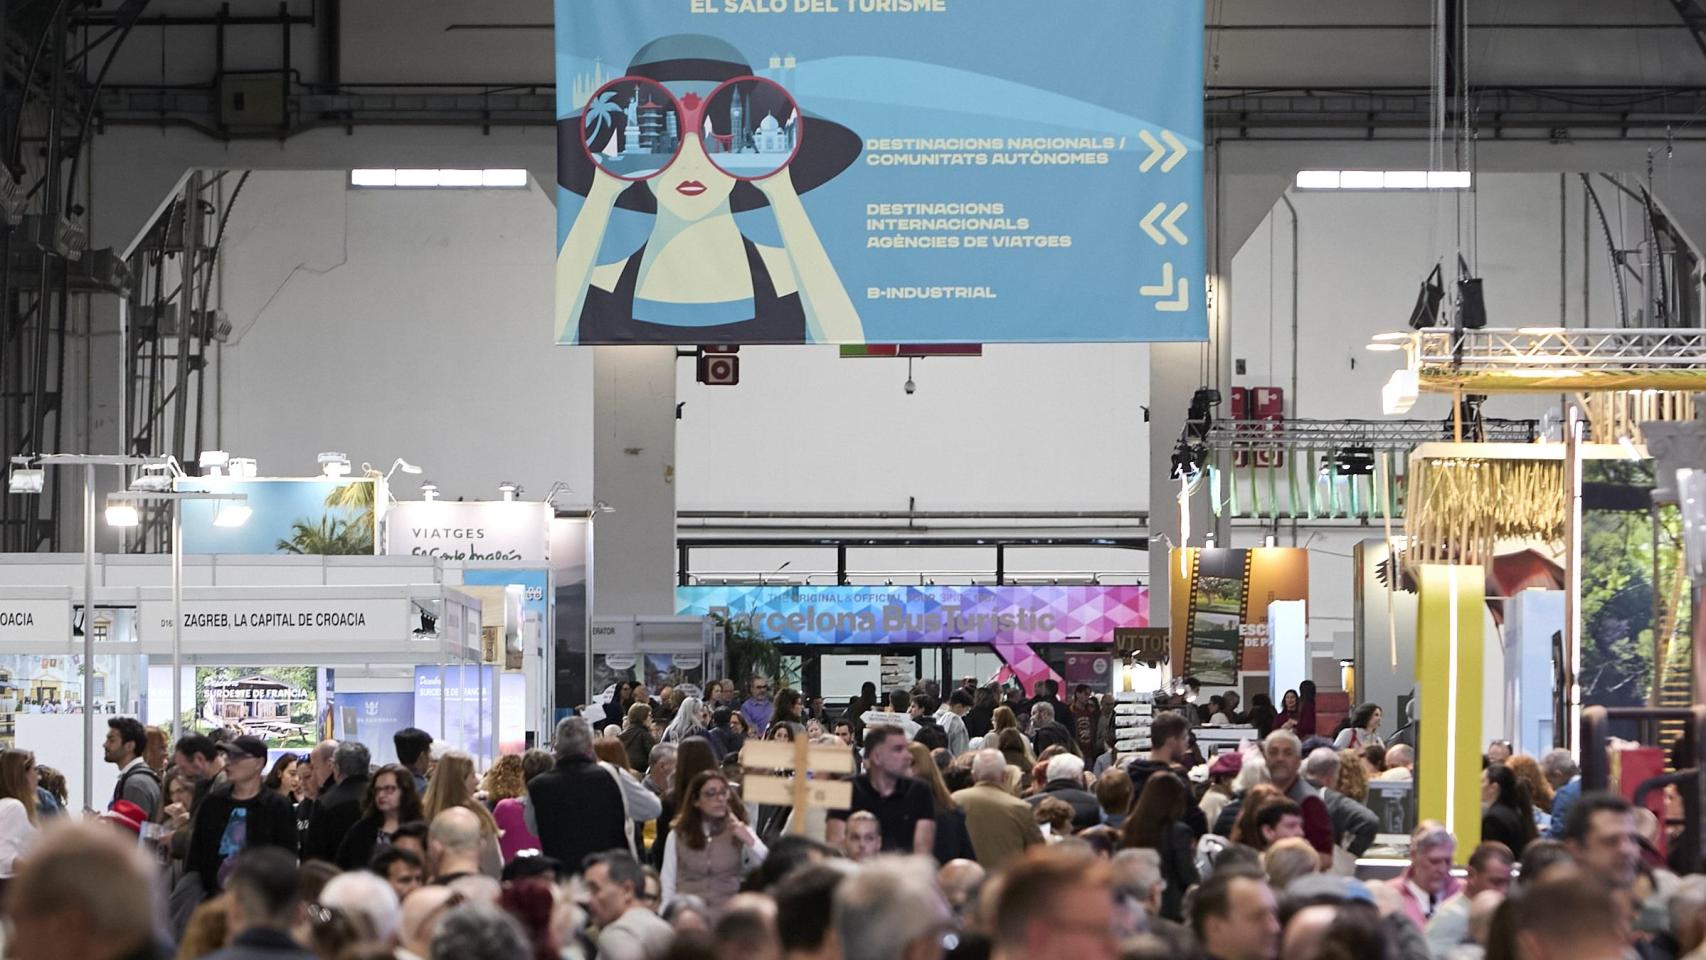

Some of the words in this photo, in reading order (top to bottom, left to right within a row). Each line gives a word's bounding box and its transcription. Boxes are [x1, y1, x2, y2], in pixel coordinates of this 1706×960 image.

[690, 0, 719, 13] EL
[794, 0, 839, 13] DEL
[848, 0, 946, 12] TURISME
[866, 138, 1004, 150] DESTINACIONS
[1008, 137, 1115, 149] NACIONALS
[1119, 137, 1126, 150] /
[866, 153, 988, 166] COMUNITATS
[991, 150, 1109, 165] AUTÒNOMES
[866, 203, 1004, 216] DESTINACIONS
[866, 218, 1029, 231] INTERNACIONALS
[866, 233, 960, 248] AGÈNCIES
[963, 236, 988, 248] DE
[992, 235, 1072, 248] VIATGES
[867, 286, 997, 299] B-INDUSTRIAL
[412, 528, 485, 539] VIATGES
[184, 613, 231, 629] ZAGREB,
[234, 613, 247, 627] LA
[250, 613, 295, 627] CAPITAL
[298, 613, 312, 627] DE
[316, 612, 366, 627] CROACIA
[1239, 623, 1270, 636] ESC
[204, 689, 250, 698] SUROESTE
[252, 689, 264, 698] DE
[266, 689, 308, 698] FRANCIA
